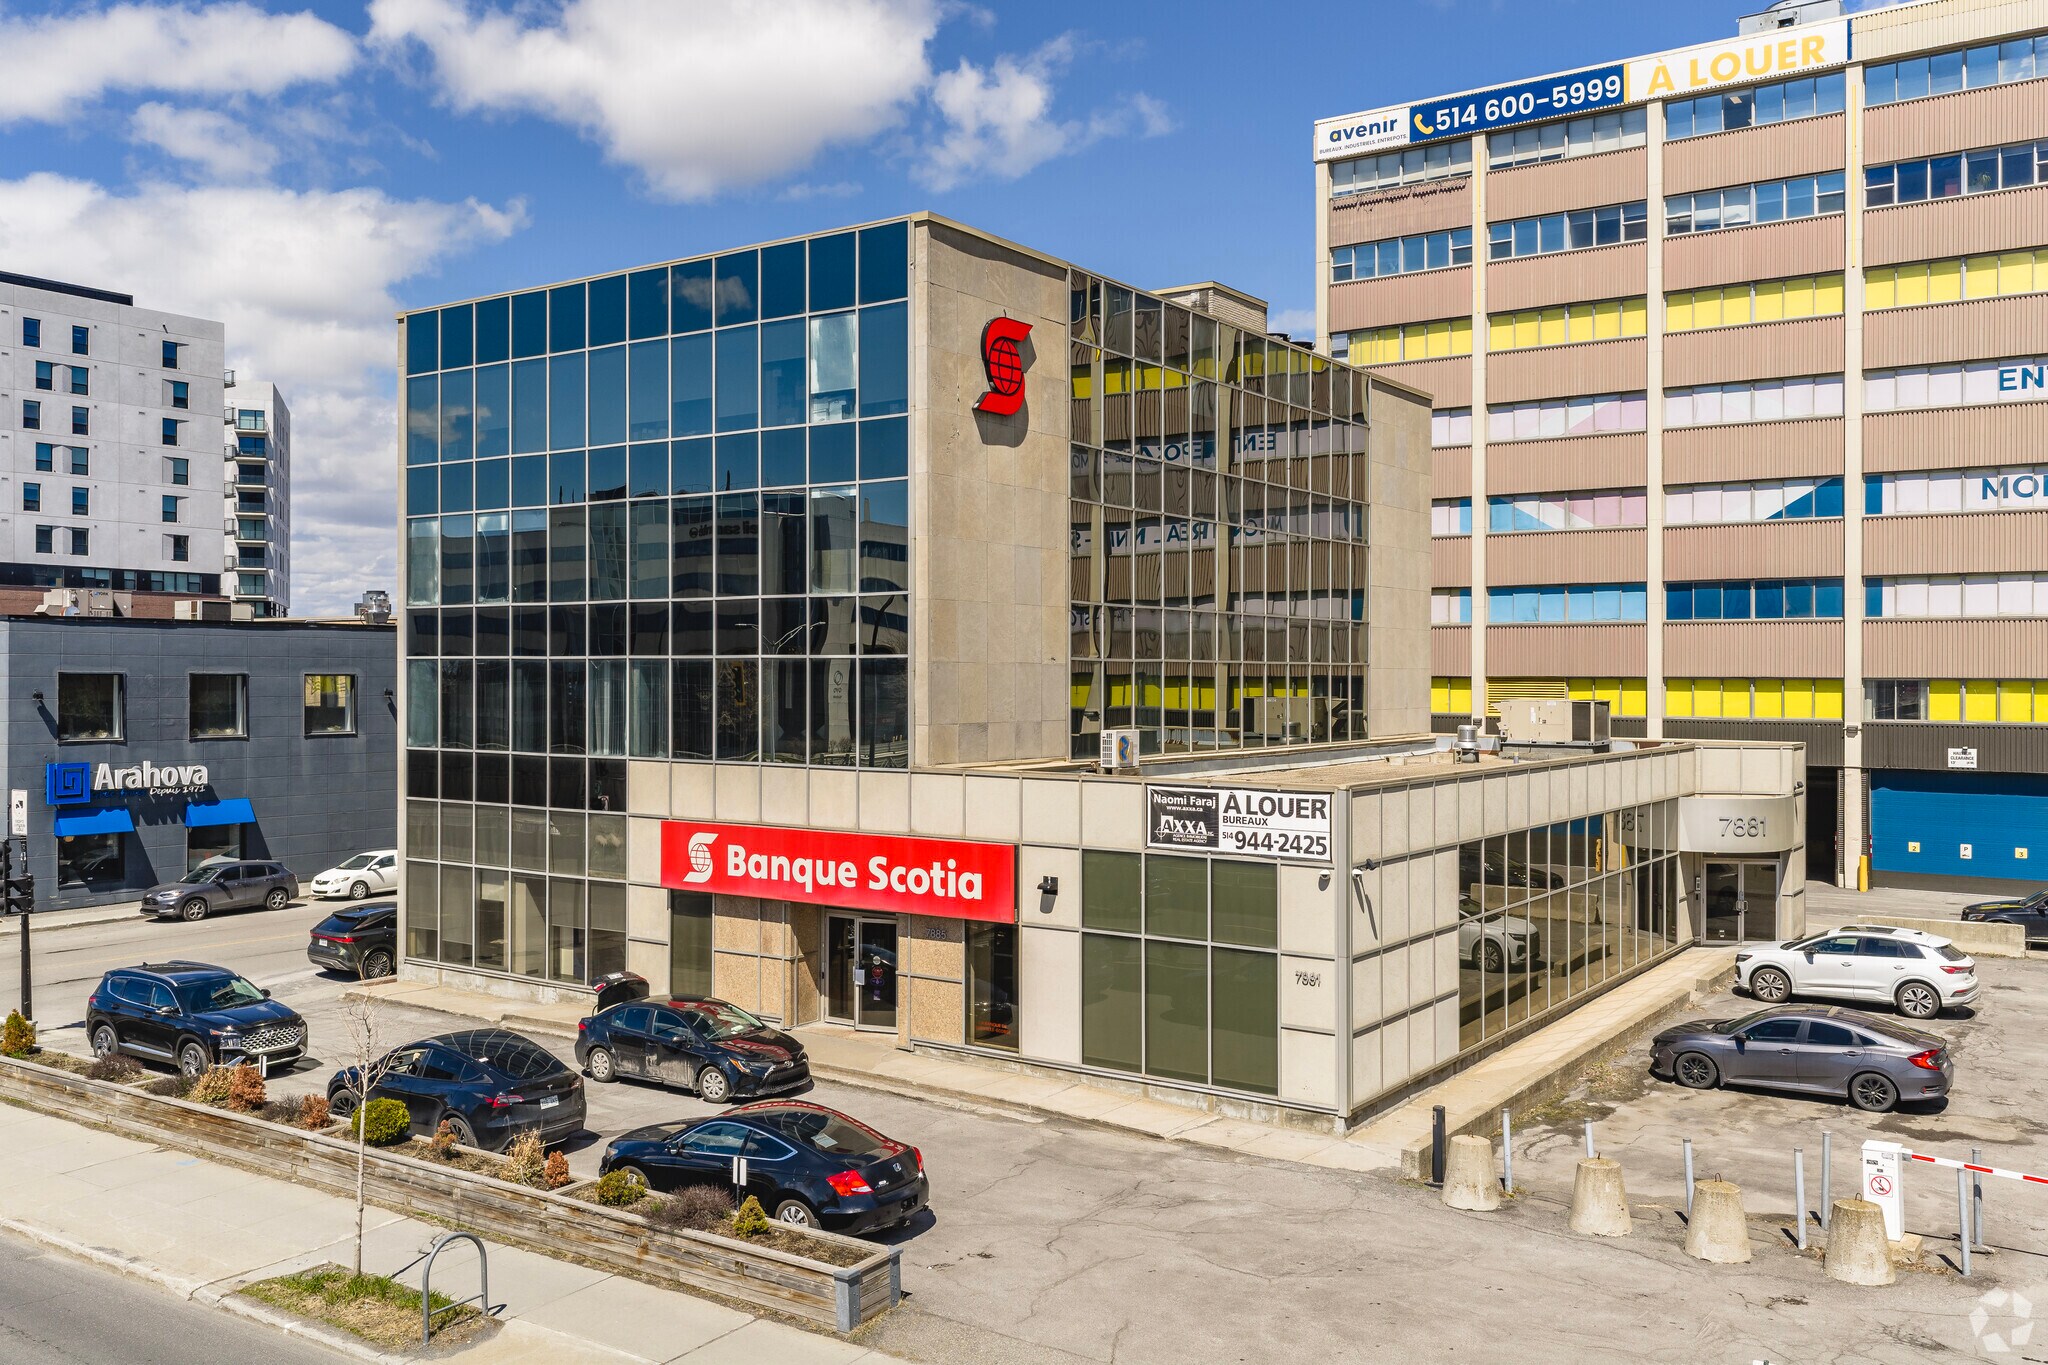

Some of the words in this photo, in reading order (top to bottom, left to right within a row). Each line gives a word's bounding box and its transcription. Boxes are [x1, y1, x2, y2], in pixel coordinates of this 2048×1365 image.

[1648, 59, 1675, 95] À
[1689, 34, 1826, 86] LOUER
[1436, 102, 1478, 131] 514
[1485, 75, 1621, 121] 600-5999
[1329, 115, 1398, 142] avenir
[1999, 366, 2048, 392] EN
[1982, 474, 2048, 500] MO
[94, 760, 208, 791] Arahova
[150, 786, 181, 796] Depuis
[182, 785, 206, 794] 1971
[1153, 793, 1187, 805] Naomi
[1190, 796, 1216, 809] Faraj
[1222, 791, 1242, 814] À
[1245, 794, 1327, 820] LOUER
[1161, 817, 1208, 835] AXXA
[1222, 815, 1268, 826] BUREAUX
[1718, 815, 1767, 838] 7881
[1222, 831, 1234, 839] 514
[1234, 830, 1327, 856] 944-2425
[727, 844, 858, 893] Banque
[868, 856, 983, 900] Scotia
[924, 928, 947, 940] 7885
